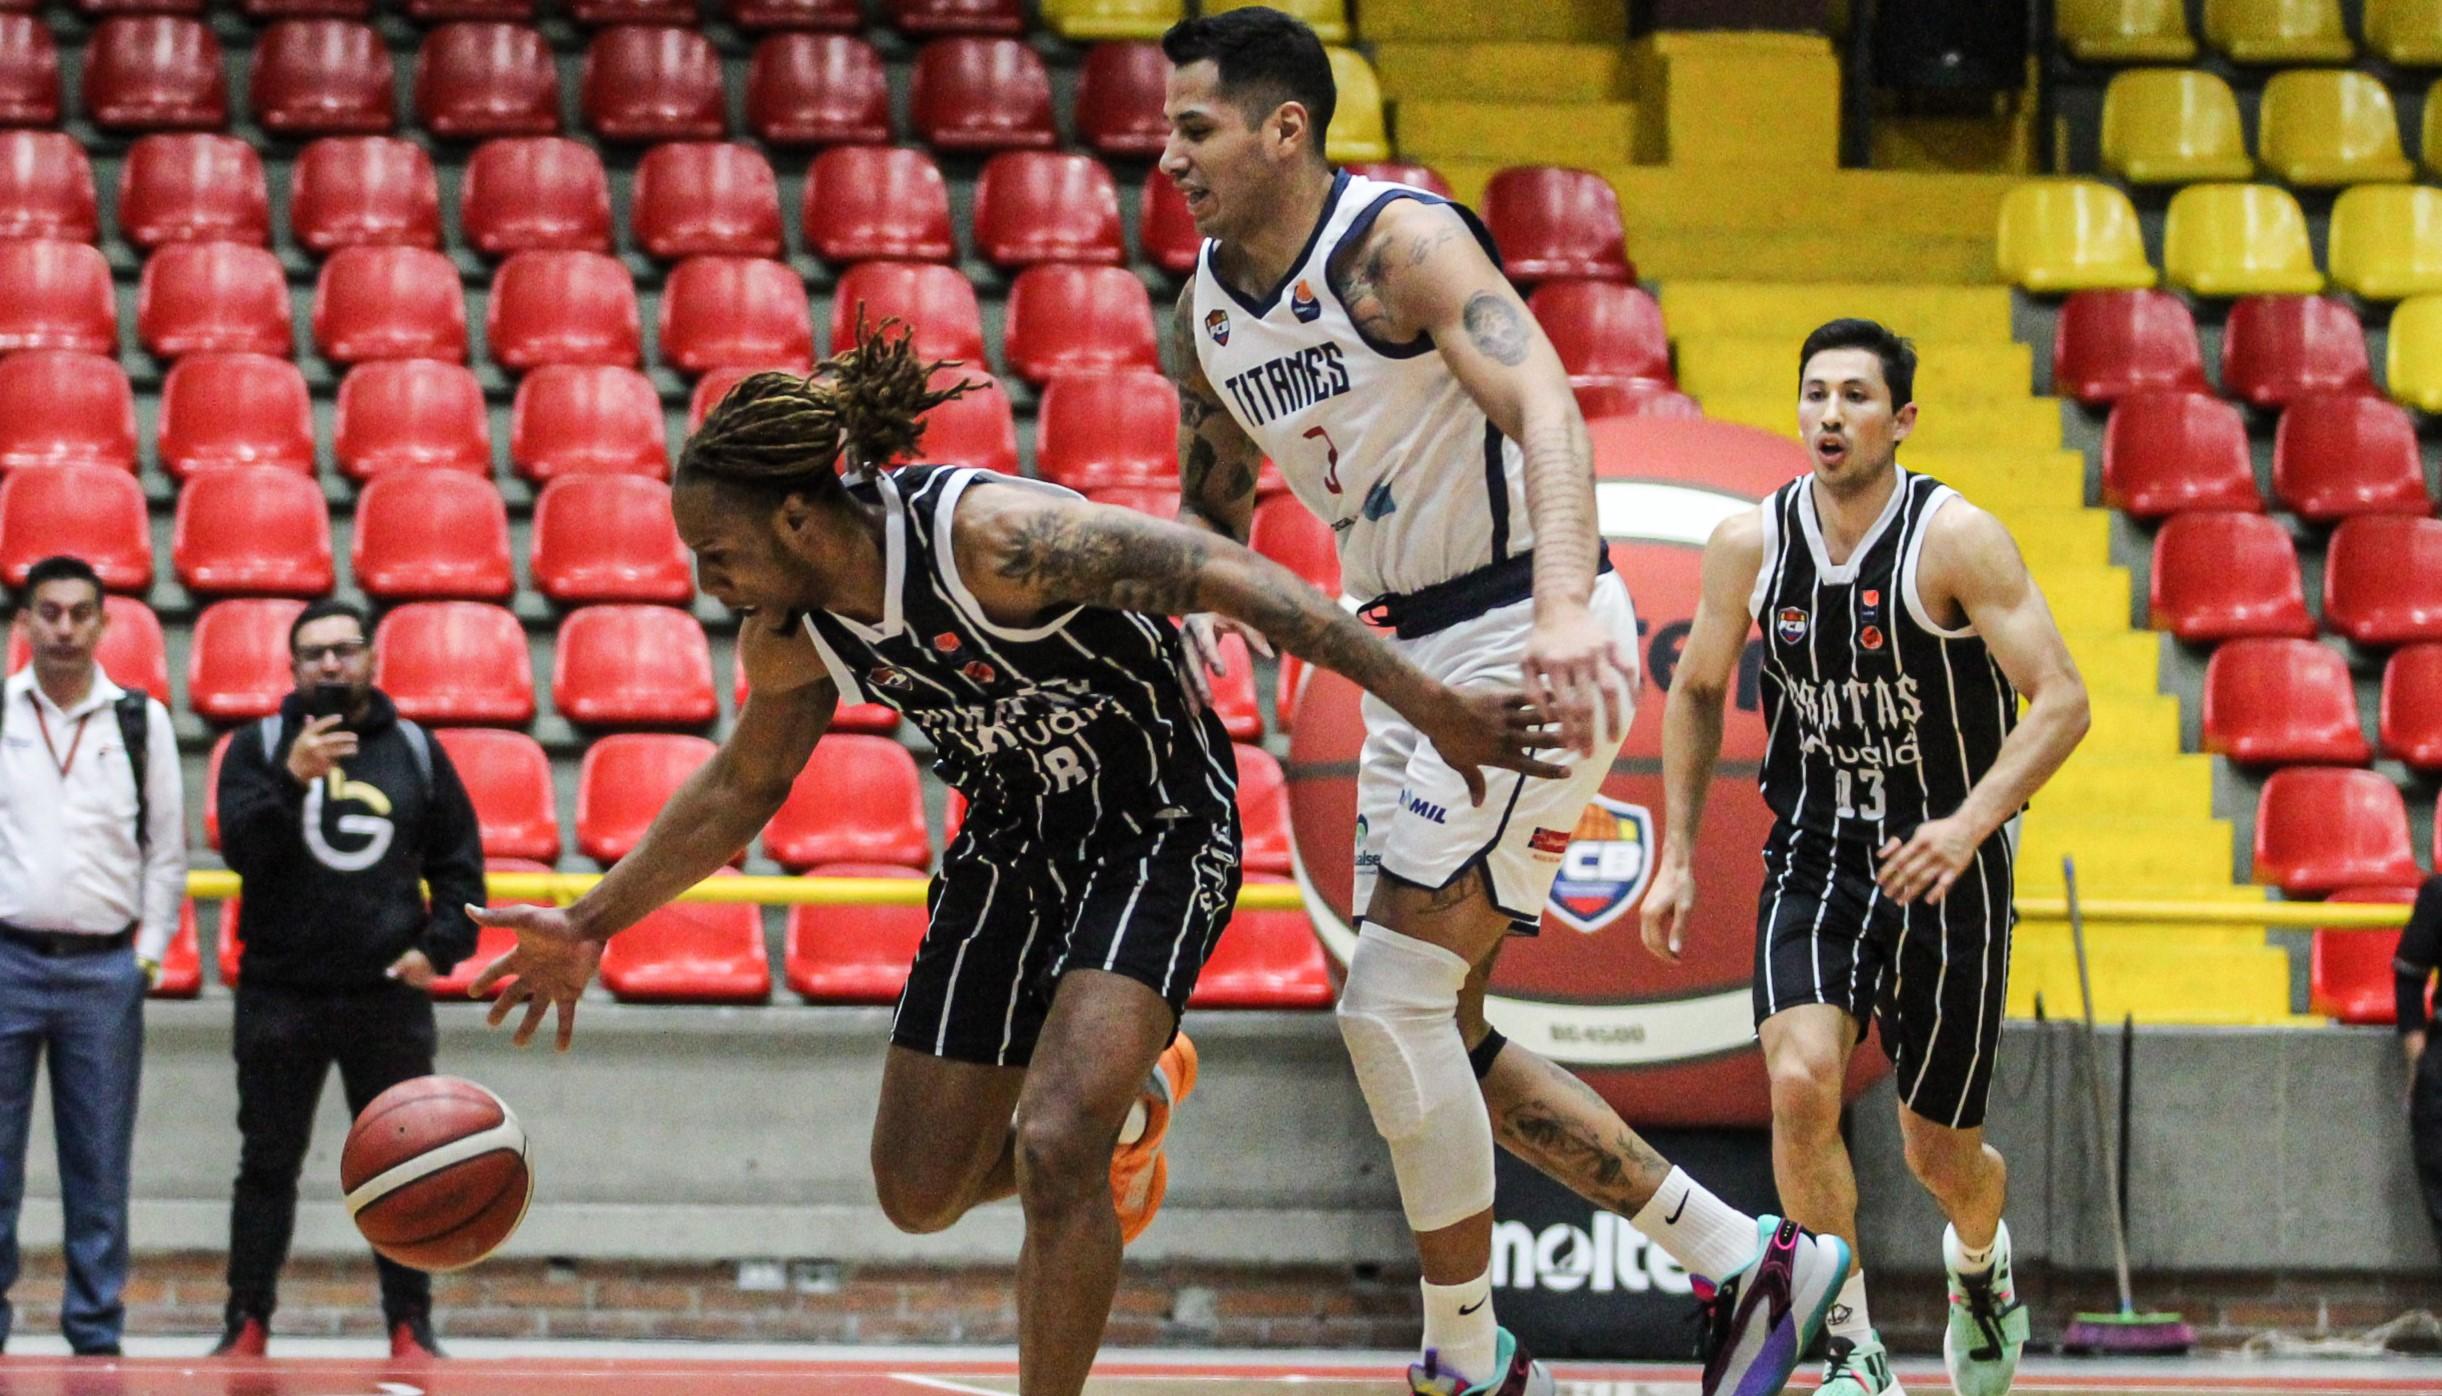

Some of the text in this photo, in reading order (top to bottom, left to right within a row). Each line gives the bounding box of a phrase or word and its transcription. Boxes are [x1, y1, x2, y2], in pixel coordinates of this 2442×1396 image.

[1225, 341, 1351, 428] TITANES
[1836, 768, 1886, 821] 13
[1492, 1210, 1693, 1294] molte
